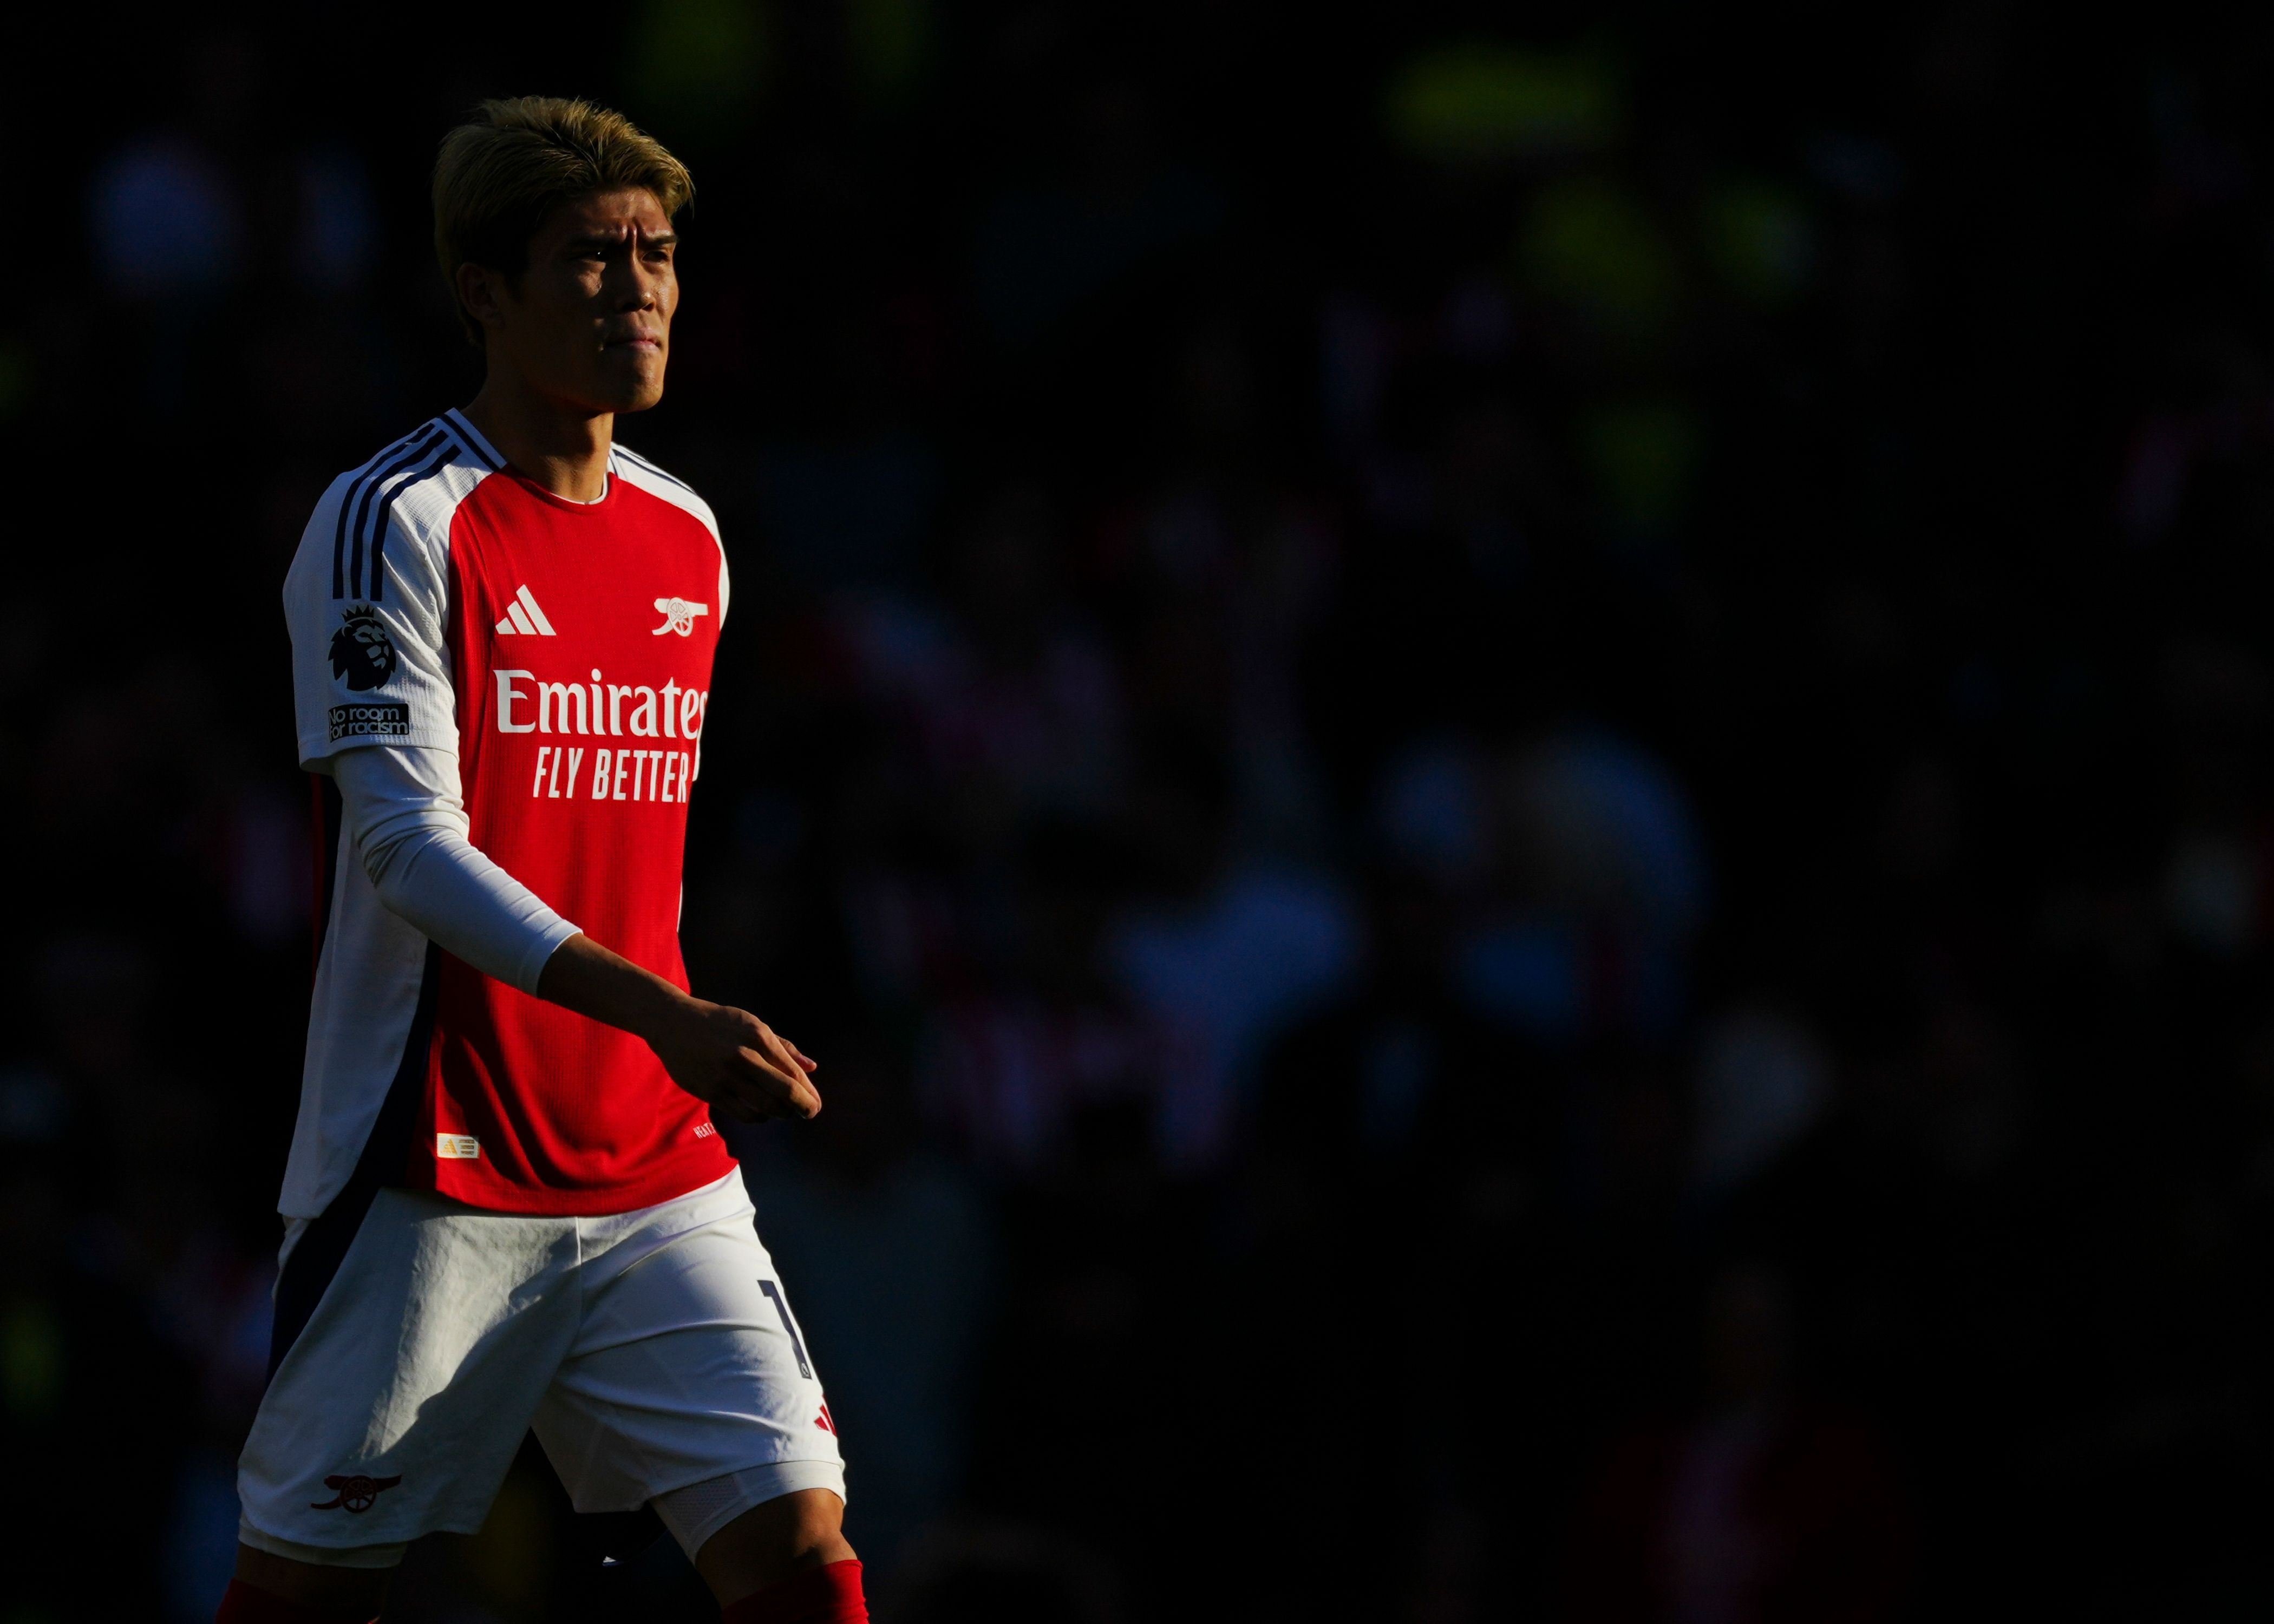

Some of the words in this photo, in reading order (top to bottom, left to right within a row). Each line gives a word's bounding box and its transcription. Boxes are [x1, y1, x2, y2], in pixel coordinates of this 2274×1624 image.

[328, 708, 346, 725] No
[349, 707, 399, 721] room
[348, 721, 408, 735] racism
[533, 746, 584, 798] FLY
[592, 749, 690, 803] BETTER
